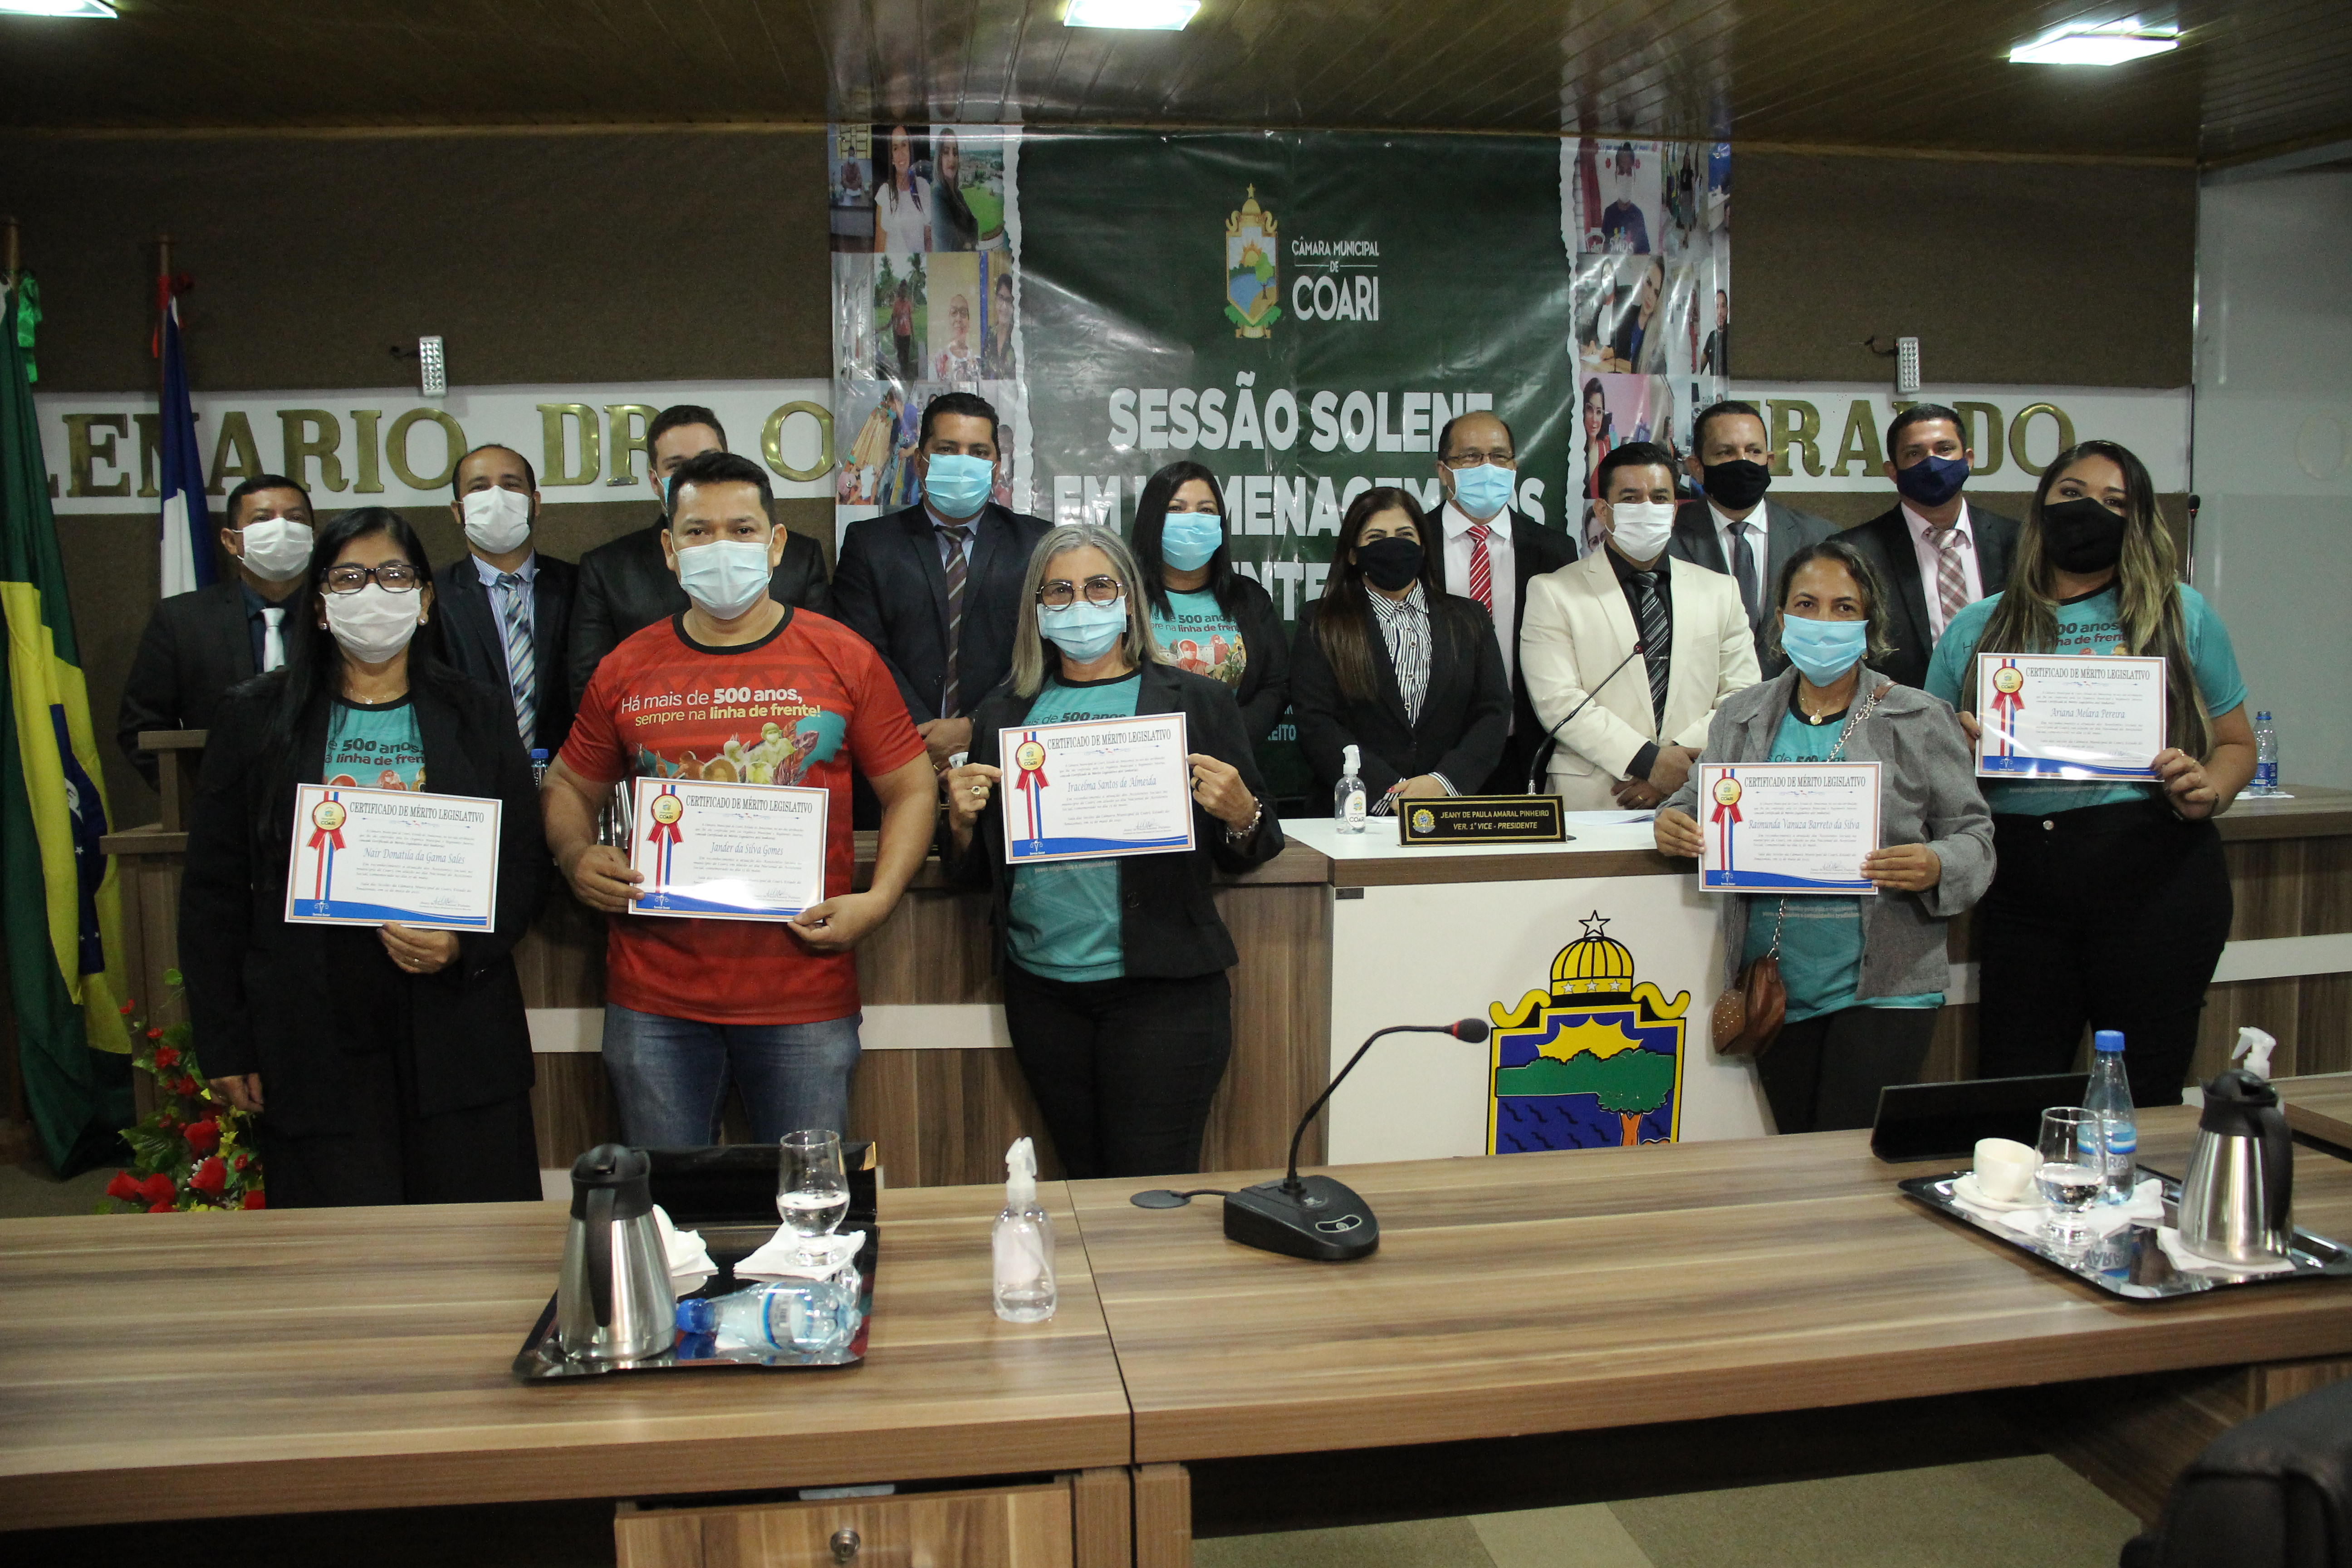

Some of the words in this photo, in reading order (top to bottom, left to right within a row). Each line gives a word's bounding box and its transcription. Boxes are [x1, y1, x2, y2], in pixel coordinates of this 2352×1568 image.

[1292, 235, 1331, 256] CÂMARA
[1333, 240, 1379, 257] MUNICIPAL
[1329, 260, 1339, 273] DE
[1292, 275, 1379, 321] COARI
[1107, 371, 1298, 451] SESSÃO
[1054, 475, 1122, 536] EM
[1179, 615, 1202, 623] 500
[1178, 624, 1202, 632] linha
[2074, 635, 2091, 645] de
[2026, 667, 2068, 677] CERTIFICADO
[2070, 669, 2079, 678] DE
[2080, 666, 2105, 679] MÉRITO
[2107, 669, 2150, 680] LEGISLATIVO
[622, 695, 640, 714] Há
[644, 691, 682, 709] mais
[686, 690, 709, 706] de
[713, 687, 751, 704] 500
[753, 688, 803, 704] anos,
[635, 710, 685, 727] sempre
[688, 710, 706, 720] na
[710, 706, 746, 719] linha
[749, 704, 768, 718] de
[770, 703, 821, 718] frente!
[1042, 714, 1058, 724] de
[1060, 711, 1090, 722] 500
[2050, 708, 2074, 717] Ariana
[2101, 709, 2125, 719] Pereira
[342, 738, 377, 751] 500
[1048, 735, 1089, 750] CERTIFICADO
[1092, 735, 1100, 746] DE
[1102, 730, 1127, 745] MÉRITO
[1128, 729, 1171, 743] LEGISLATIVO
[336, 753, 371, 764] linha
[374, 756, 393, 765] de
[1068, 779, 1096, 792] Iracelma
[1098, 779, 1118, 790] Santos
[1120, 776, 1127, 788] de
[1129, 774, 1156, 787] Almeida
[1744, 777, 1786, 787] CERTIFICADO
[1787, 777, 1795, 787] DE
[1797, 774, 1822, 787] MÉRITO
[1823, 776, 1866, 787] LEGISLATIVO
[686, 795, 730, 808] CERTIFICADO
[732, 798, 741, 809] DE
[742, 796, 768, 811] MÉRITO
[769, 800, 813, 813] LEGISLATIVO
[350, 802, 397, 816] CERTIFICADO
[398, 805, 408, 816] DE
[410, 804, 437, 819] MÉRITO
[439, 808, 484, 823] LEGISLATIVO
[1748, 818, 1780, 829] Raimunda
[1782, 818, 1806, 829] Vanuza
[1808, 819, 1833, 829] Barreto
[1833, 818, 1842, 829] da
[1843, 818, 1860, 829] Silva
[363, 848, 381, 858] Nair
[383, 848, 414, 860] Donatila
[415, 850, 424, 861] da
[426, 852, 446, 864] Gama
[448, 853, 465, 864] Sales
[710, 842, 734, 853] Jander
[735, 842, 743, 853] da
[745, 843, 761, 854] Silva
[763, 844, 784, 857] Gomes
